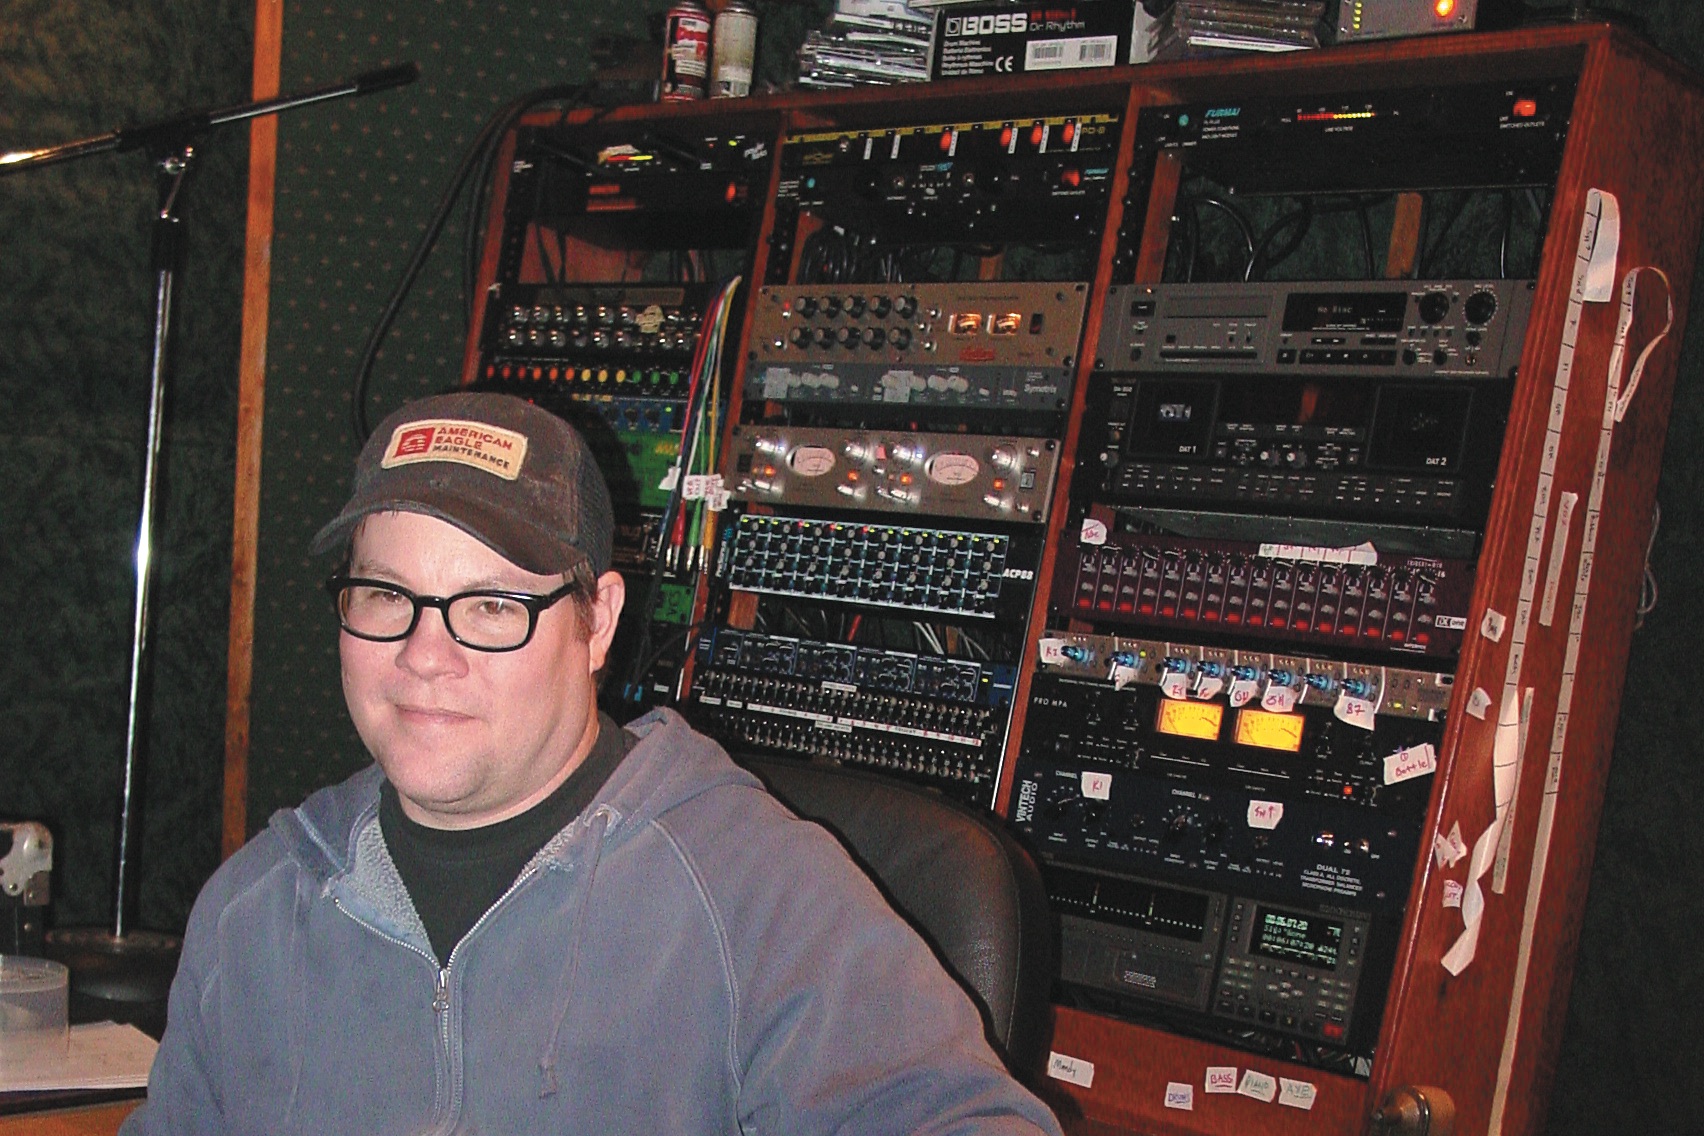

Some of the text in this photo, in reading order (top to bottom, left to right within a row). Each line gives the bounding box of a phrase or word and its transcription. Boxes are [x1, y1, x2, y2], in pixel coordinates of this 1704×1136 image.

[961, 13, 1028, 36] BOSS
[1046, 20, 1086, 33] Rhythm
[434, 436, 483, 450] EAGLE
[437, 426, 513, 450] AMERICAN
[432, 445, 510, 469] MAINTENANCE
[1002, 568, 1034, 580] ACP88
[1014, 779, 1033, 822] VINTECH
[1025, 782, 1038, 822] AUDIO
[1316, 863, 1339, 874] DUAL
[1210, 1073, 1234, 1084] BASS
